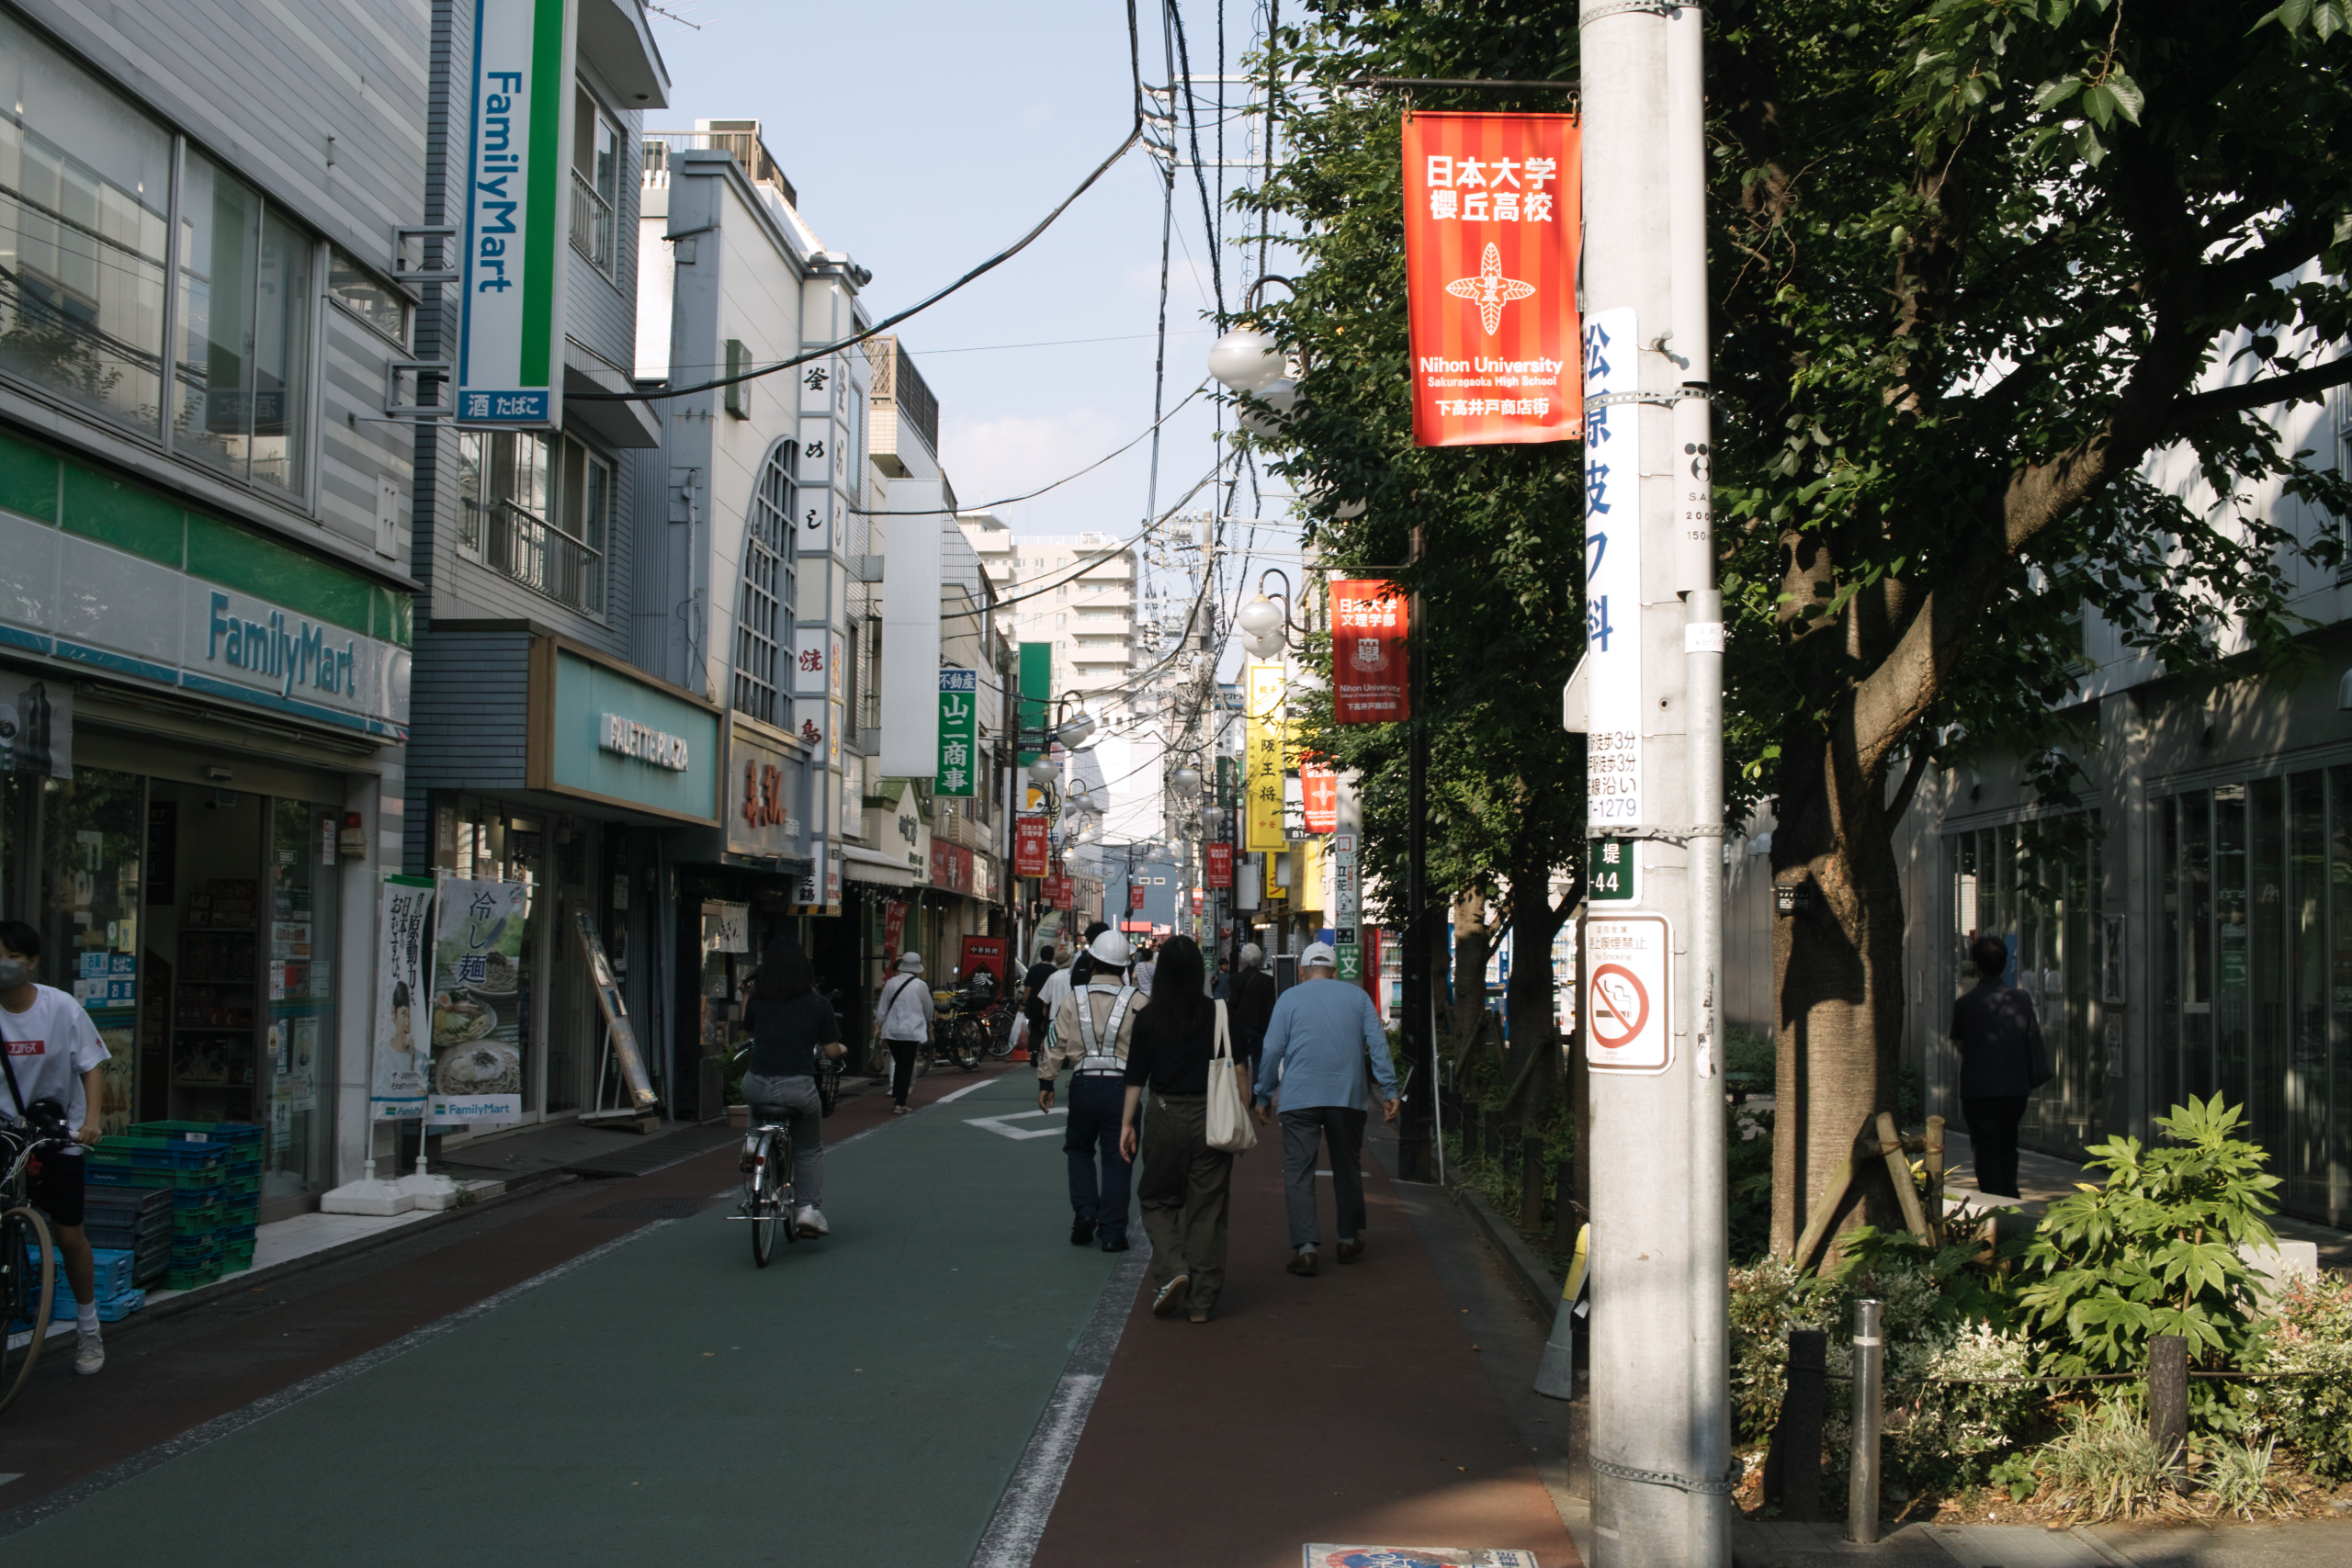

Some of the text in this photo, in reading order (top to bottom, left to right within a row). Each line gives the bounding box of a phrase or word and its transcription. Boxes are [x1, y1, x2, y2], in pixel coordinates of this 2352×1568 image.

[1427, 155, 1556, 189] 日本大学
[479, 72, 522, 293] FamilyMart
[1430, 191, 1553, 222] 櫻丘高校
[1420, 356, 1564, 376] Nihon University
[1428, 375, 1556, 389] Sakuragaoka High School
[468, 394, 540, 417] 酒 たばこ
[1435, 397, 1550, 419] 下高井戸商店街
[803, 367, 830, 530] 釜めし
[1340, 598, 1396, 614] 日本大学
[1341, 614, 1396, 627] 文理学部
[208, 590, 356, 699] FamilyMart
[939, 672, 975, 690] 不動産
[1340, 683, 1401, 693] Nihon University
[1347, 701, 1396, 711] 下高井戸商店街
[602, 714, 659, 764] PALETTE
[941, 694, 969, 794] 山二商事
[1260, 713, 1277, 803] 大阪王将
[1259, 820, 1277, 829] 中華
[1589, 872, 1620, 892] -44
[458, 891, 497, 984] 冷し麺
[970, 946, 999, 954] 中華料理
[1602, 953, 1633, 961] Smoking
[1340, 955, 1358, 974] 文
[449, 1103, 510, 1115] FamilyMart
